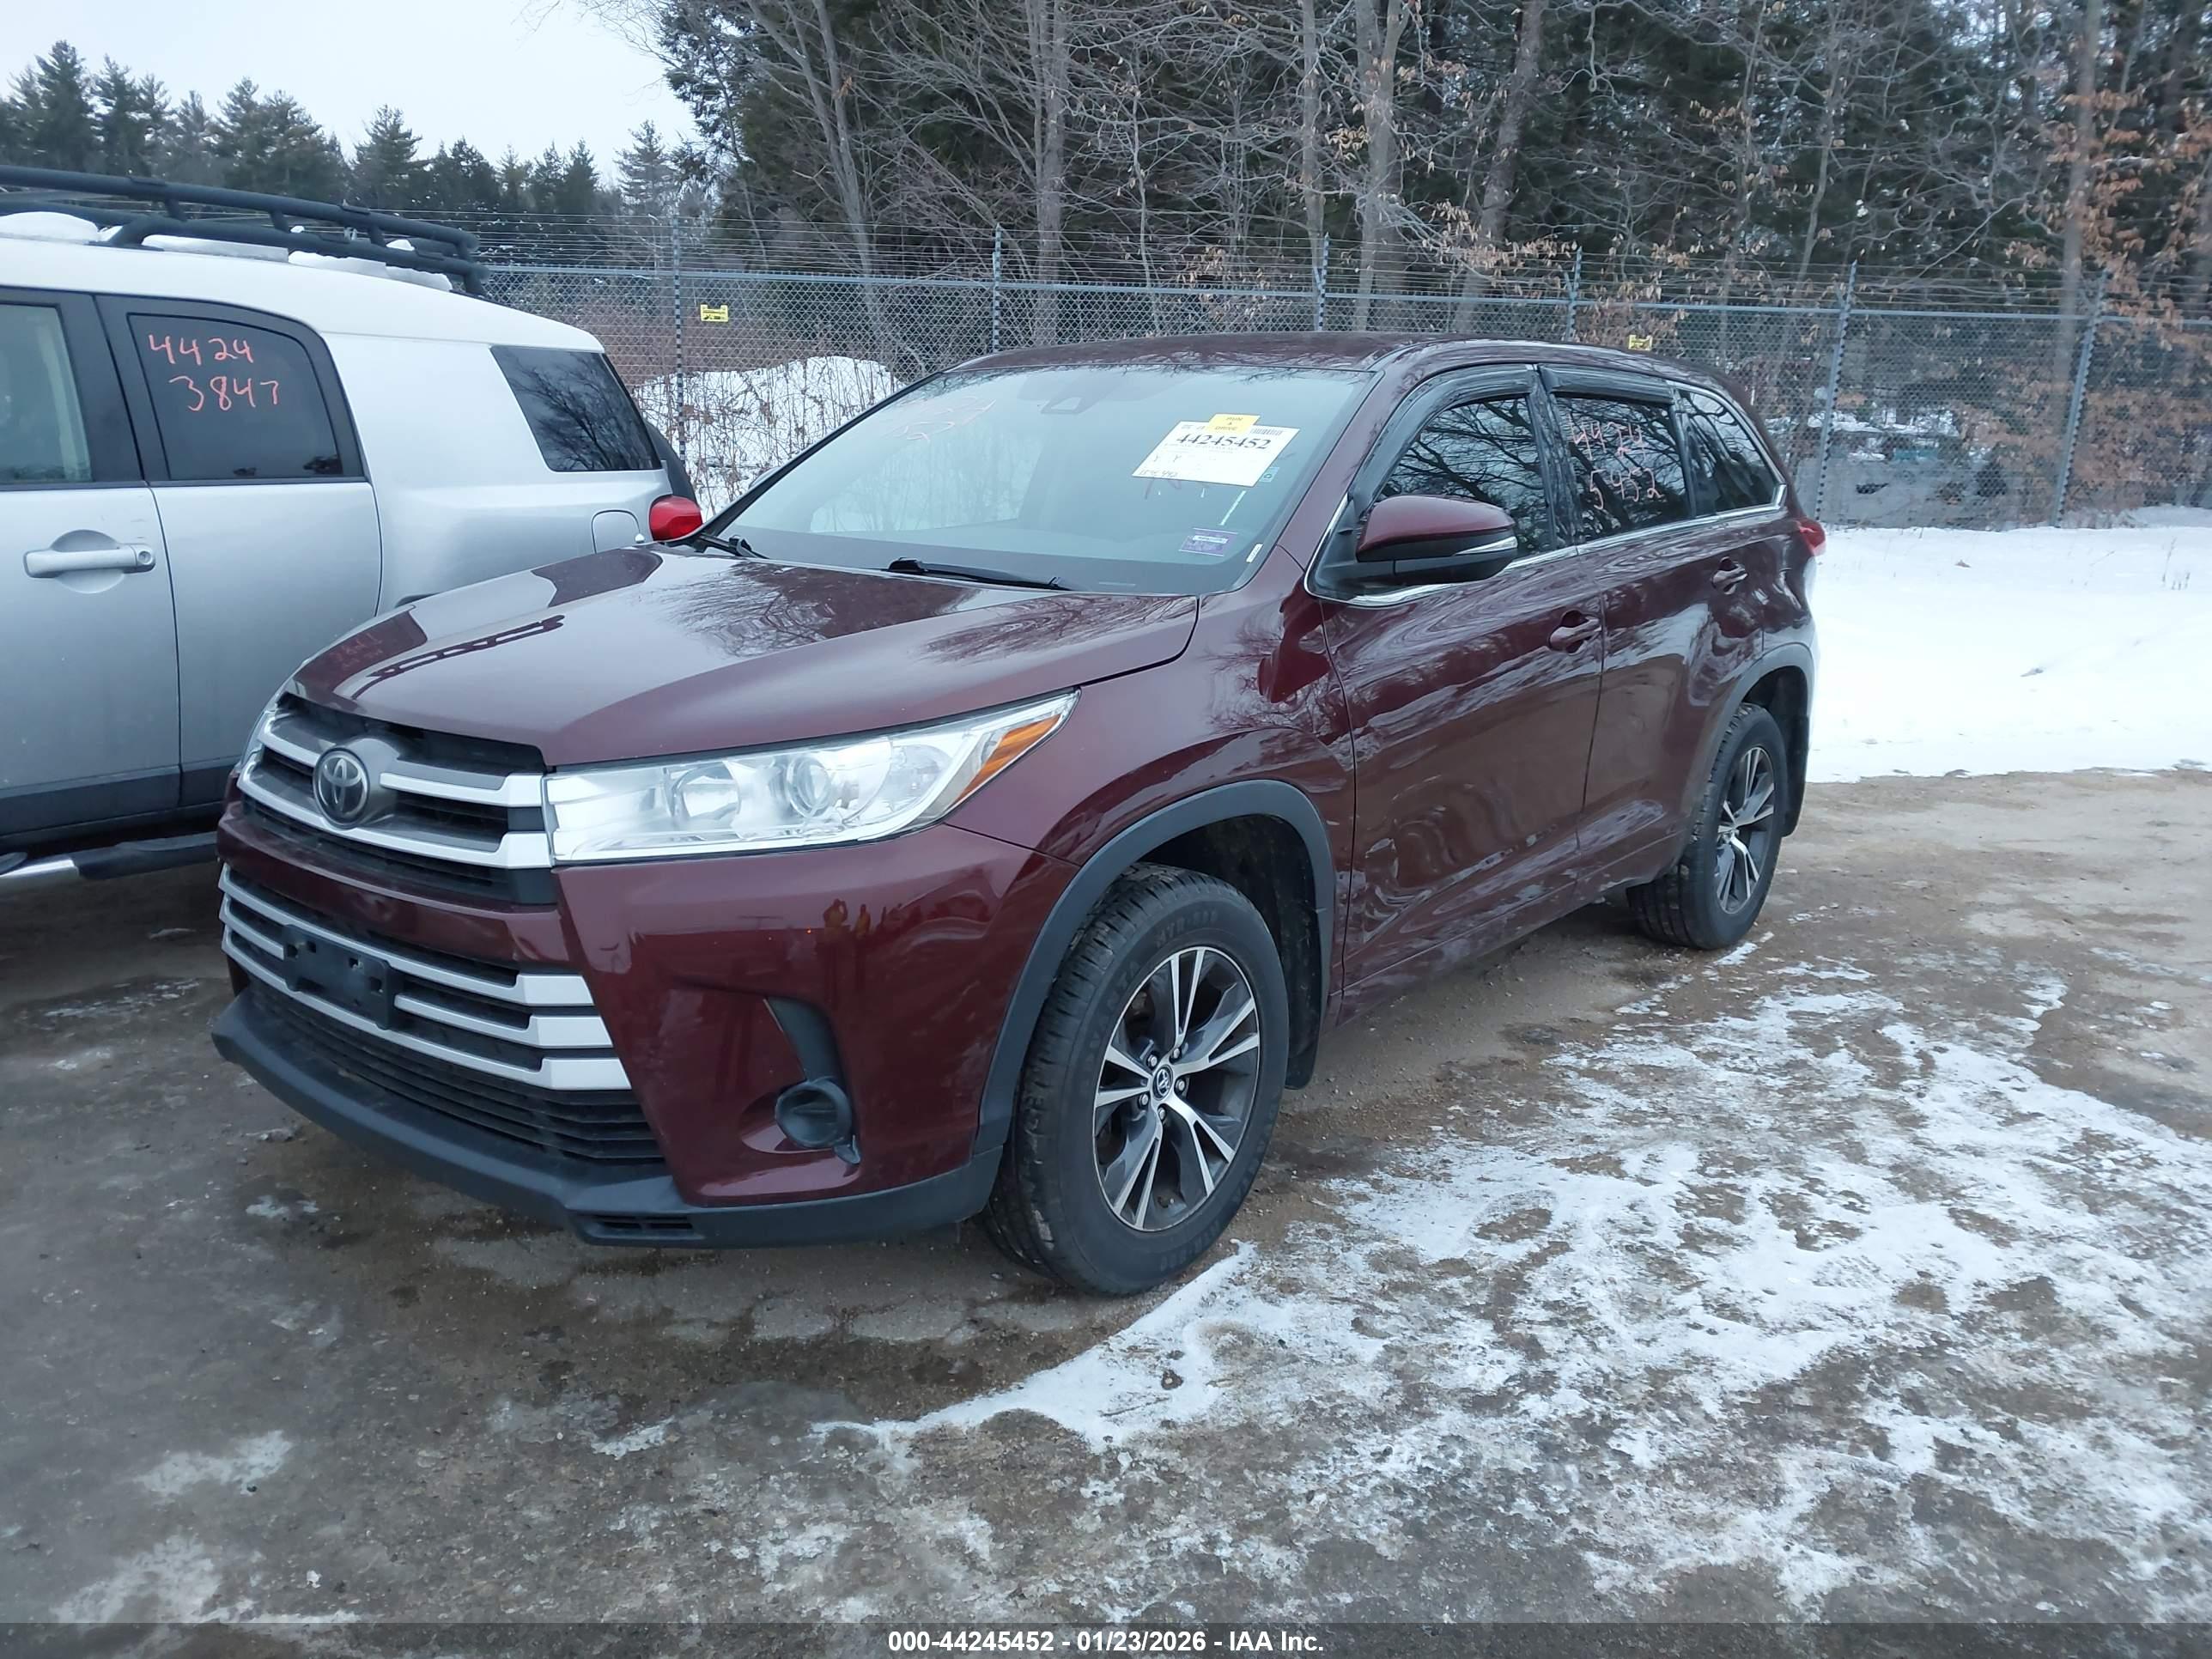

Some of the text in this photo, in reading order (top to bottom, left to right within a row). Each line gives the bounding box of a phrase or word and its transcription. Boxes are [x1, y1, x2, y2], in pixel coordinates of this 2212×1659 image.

[149, 334, 255, 366] 4424
[168, 375, 280, 411] 3847
[1176, 433, 1272, 450] 44245452
[1589, 467, 1664, 510] 5452
